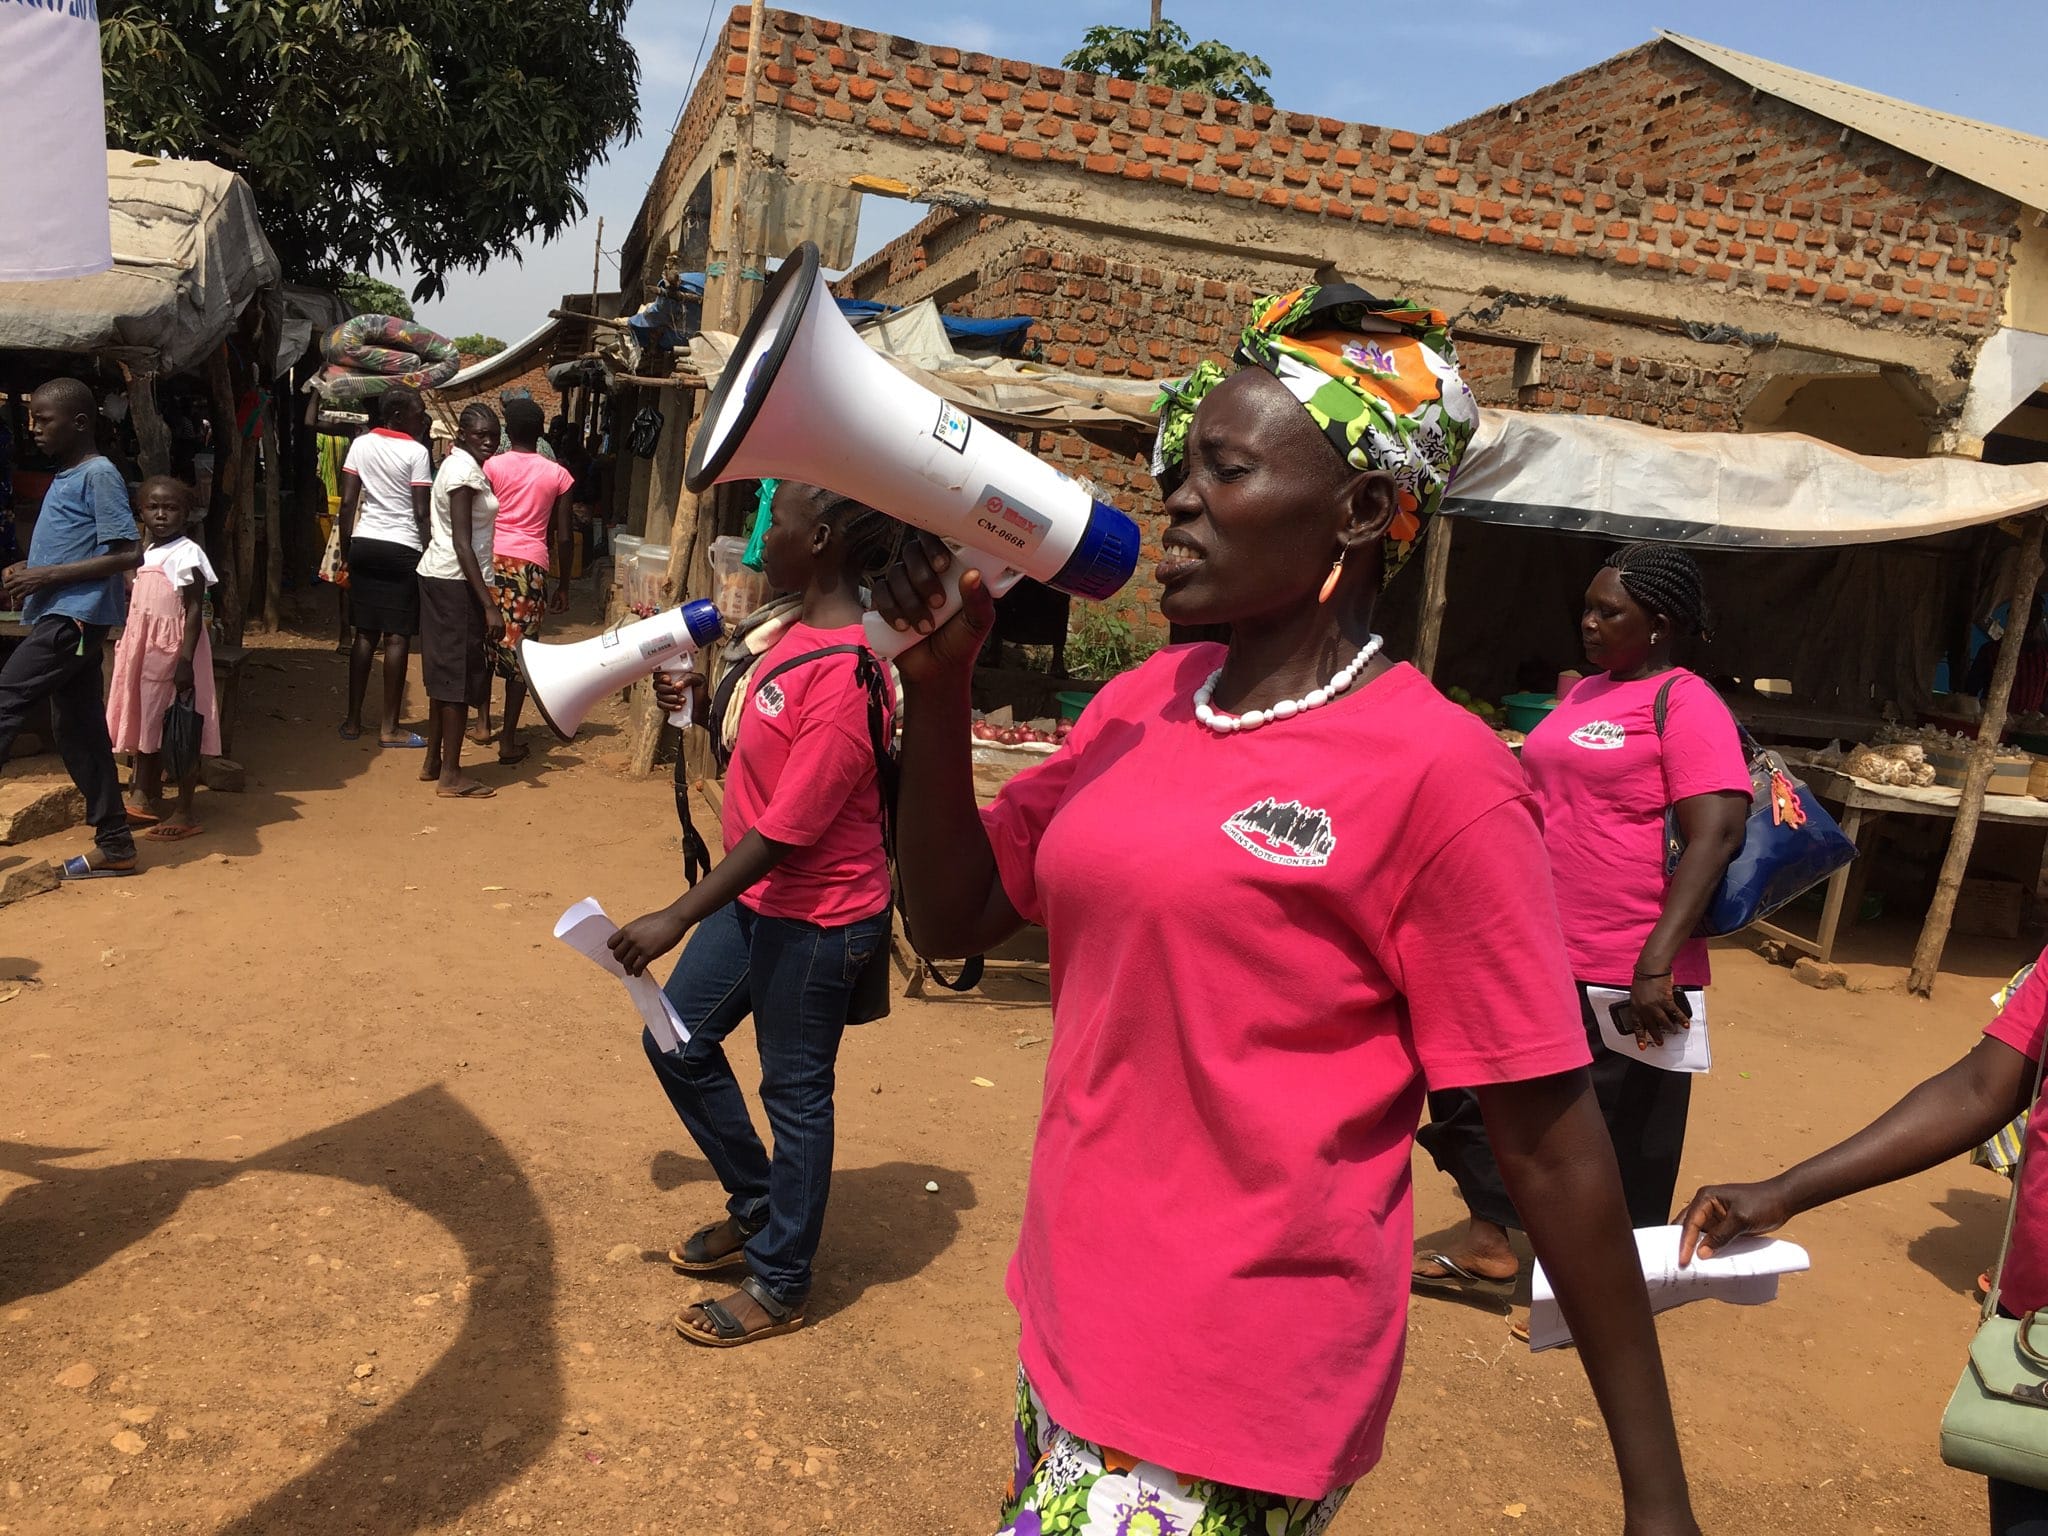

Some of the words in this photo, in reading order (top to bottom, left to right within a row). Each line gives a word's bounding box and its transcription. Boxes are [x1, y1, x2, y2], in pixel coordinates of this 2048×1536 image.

[977, 518, 1026, 549] CM-066R
[1248, 844, 1300, 865] PROTECTION
[1301, 858, 1325, 866] TEAM
